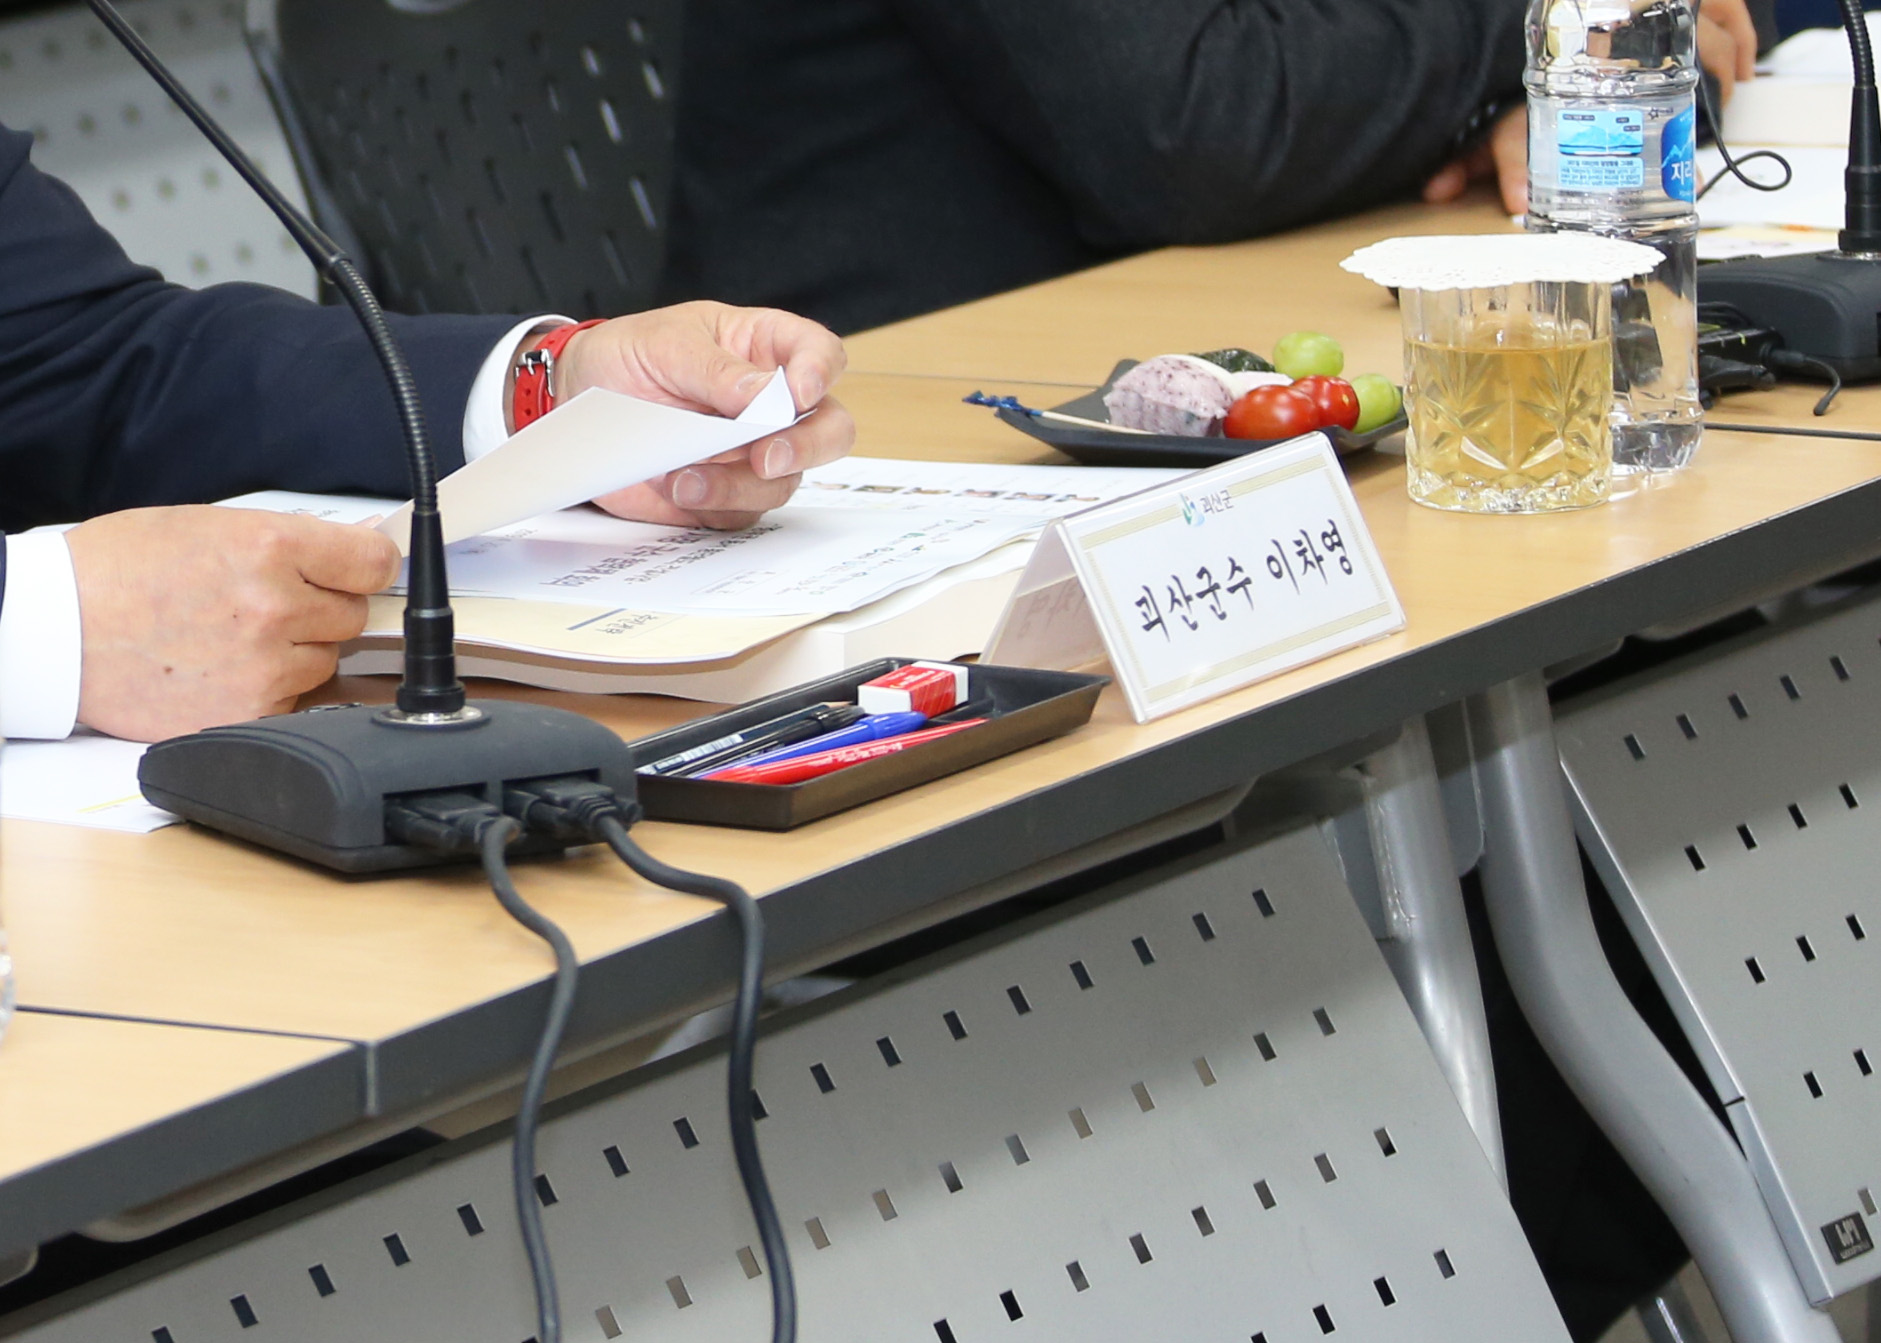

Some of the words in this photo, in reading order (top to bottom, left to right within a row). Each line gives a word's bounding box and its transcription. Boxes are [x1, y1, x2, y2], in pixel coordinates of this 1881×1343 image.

[1199, 489, 1235, 516] 괴산군
[1134, 556, 1255, 643] 괴산군수
[1265, 518, 1354, 596] 이차영
